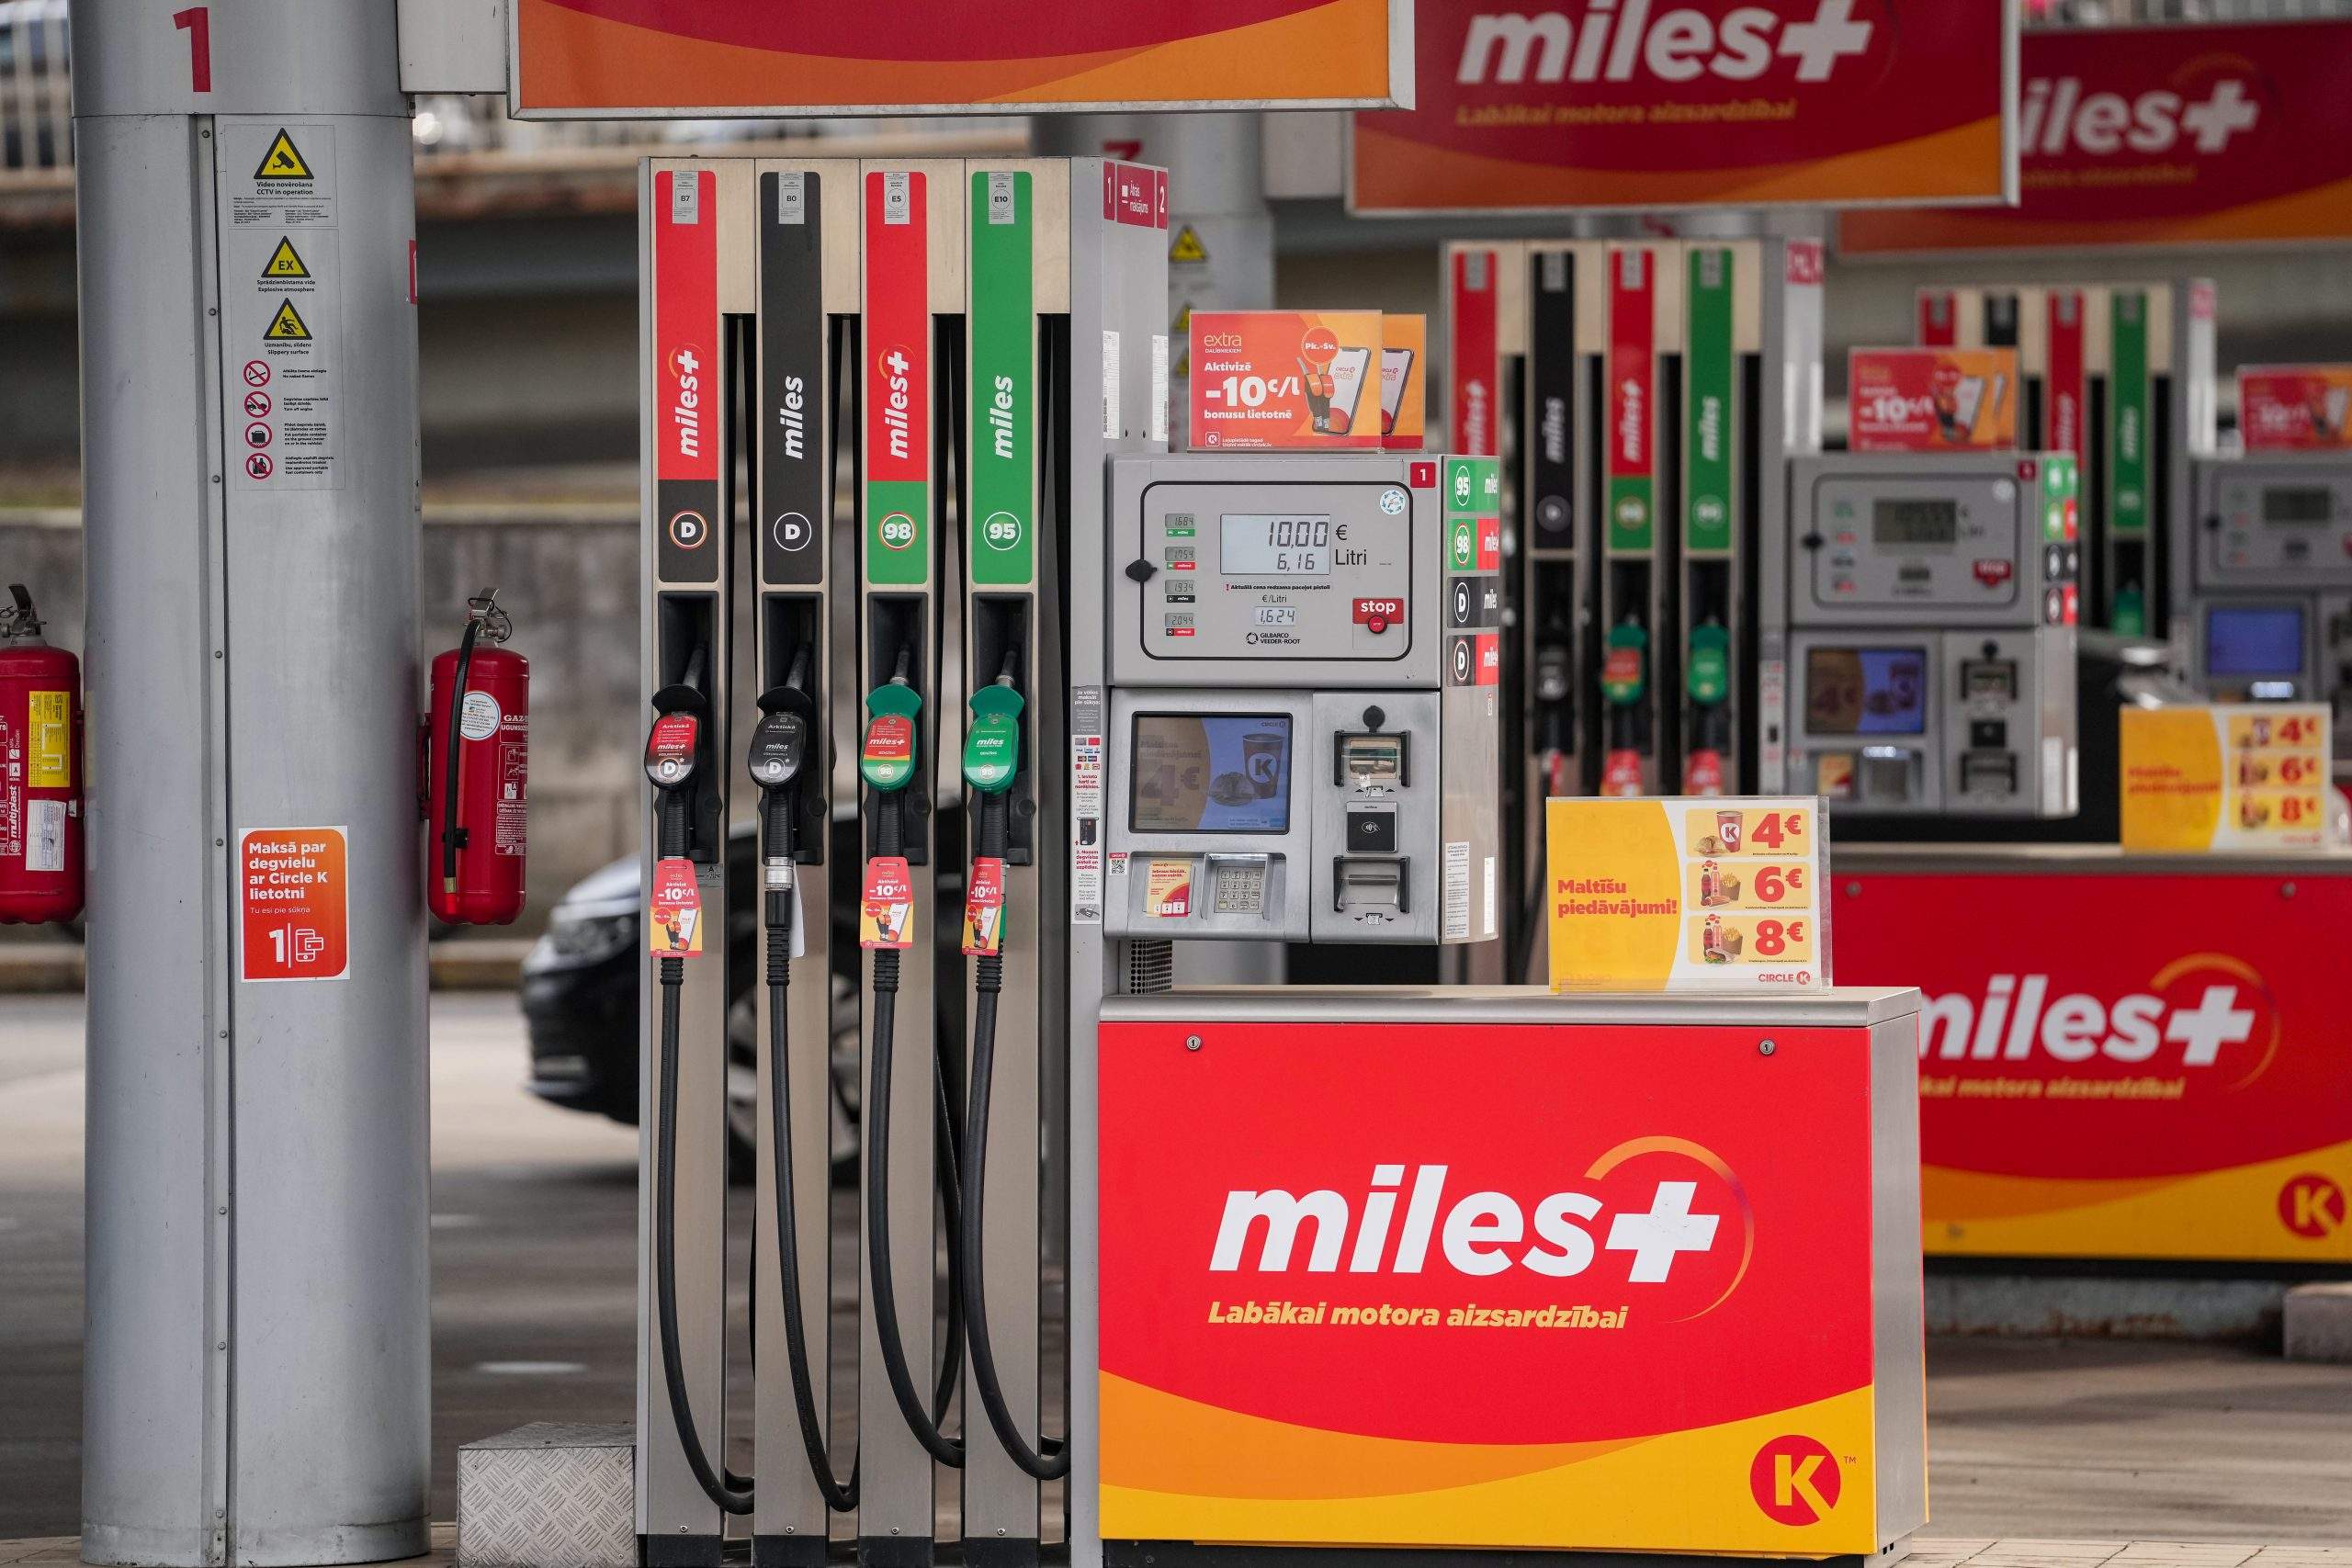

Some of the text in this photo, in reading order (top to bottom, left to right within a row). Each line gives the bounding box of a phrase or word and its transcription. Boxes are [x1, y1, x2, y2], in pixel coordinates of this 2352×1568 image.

[173, 7, 210, 92] 1
[1456, 0, 1872, 84] miles+
[1555, 103, 1645, 123] motora
[2021, 76, 2260, 154] iles+
[1107, 176, 1112, 204] 1
[1159, 186, 1165, 213] 2
[278, 260, 294, 271] EX
[1204, 333, 1242, 347] extra
[1204, 362, 1251, 372] Aktivizē
[673, 350, 699, 457] miles+
[885, 350, 909, 458] miles+
[779, 375, 803, 459] miles
[989, 375, 1013, 459] miles
[1204, 409, 1293, 419] bonusu lietotnē
[1419, 468, 1426, 481] 1
[1456, 476, 1469, 496] 95
[681, 521, 696, 538] D
[786, 524, 800, 540] D
[884, 522, 911, 540] 98
[989, 522, 1016, 540] 95
[1268, 521, 1348, 548] 10,00 €
[1456, 530, 1499, 554] 98 miles
[1277, 548, 1367, 571] 6,16 Litri
[1361, 600, 1396, 615] stop
[1458, 592, 1466, 613] D
[1457, 646, 1498, 671] D miles
[869, 738, 905, 746] miles+
[663, 761, 676, 774] D
[769, 761, 782, 774] D
[1254, 758, 1275, 780] K
[9, 785, 18, 838] multiplast
[1724, 827, 1738, 840] K
[1751, 813, 1802, 849] 4€
[249, 841, 327, 855] Maksā par
[249, 857, 316, 871] degvielu
[249, 872, 328, 885] ar Circle K
[1557, 878, 1627, 894] Maltīšu
[1754, 865, 1804, 902] 6€
[249, 887, 305, 900] lietotni
[275, 906, 287, 915] pie
[1557, 897, 1678, 918] piedāvājumi!
[269, 929, 285, 963] 1
[1755, 919, 1804, 955] 8€
[1758, 973, 1794, 983] CIRCLE
[1209, 1164, 1720, 1283] miles+
[1208, 1301, 1628, 1330] Labākai motora aizsardzībai
